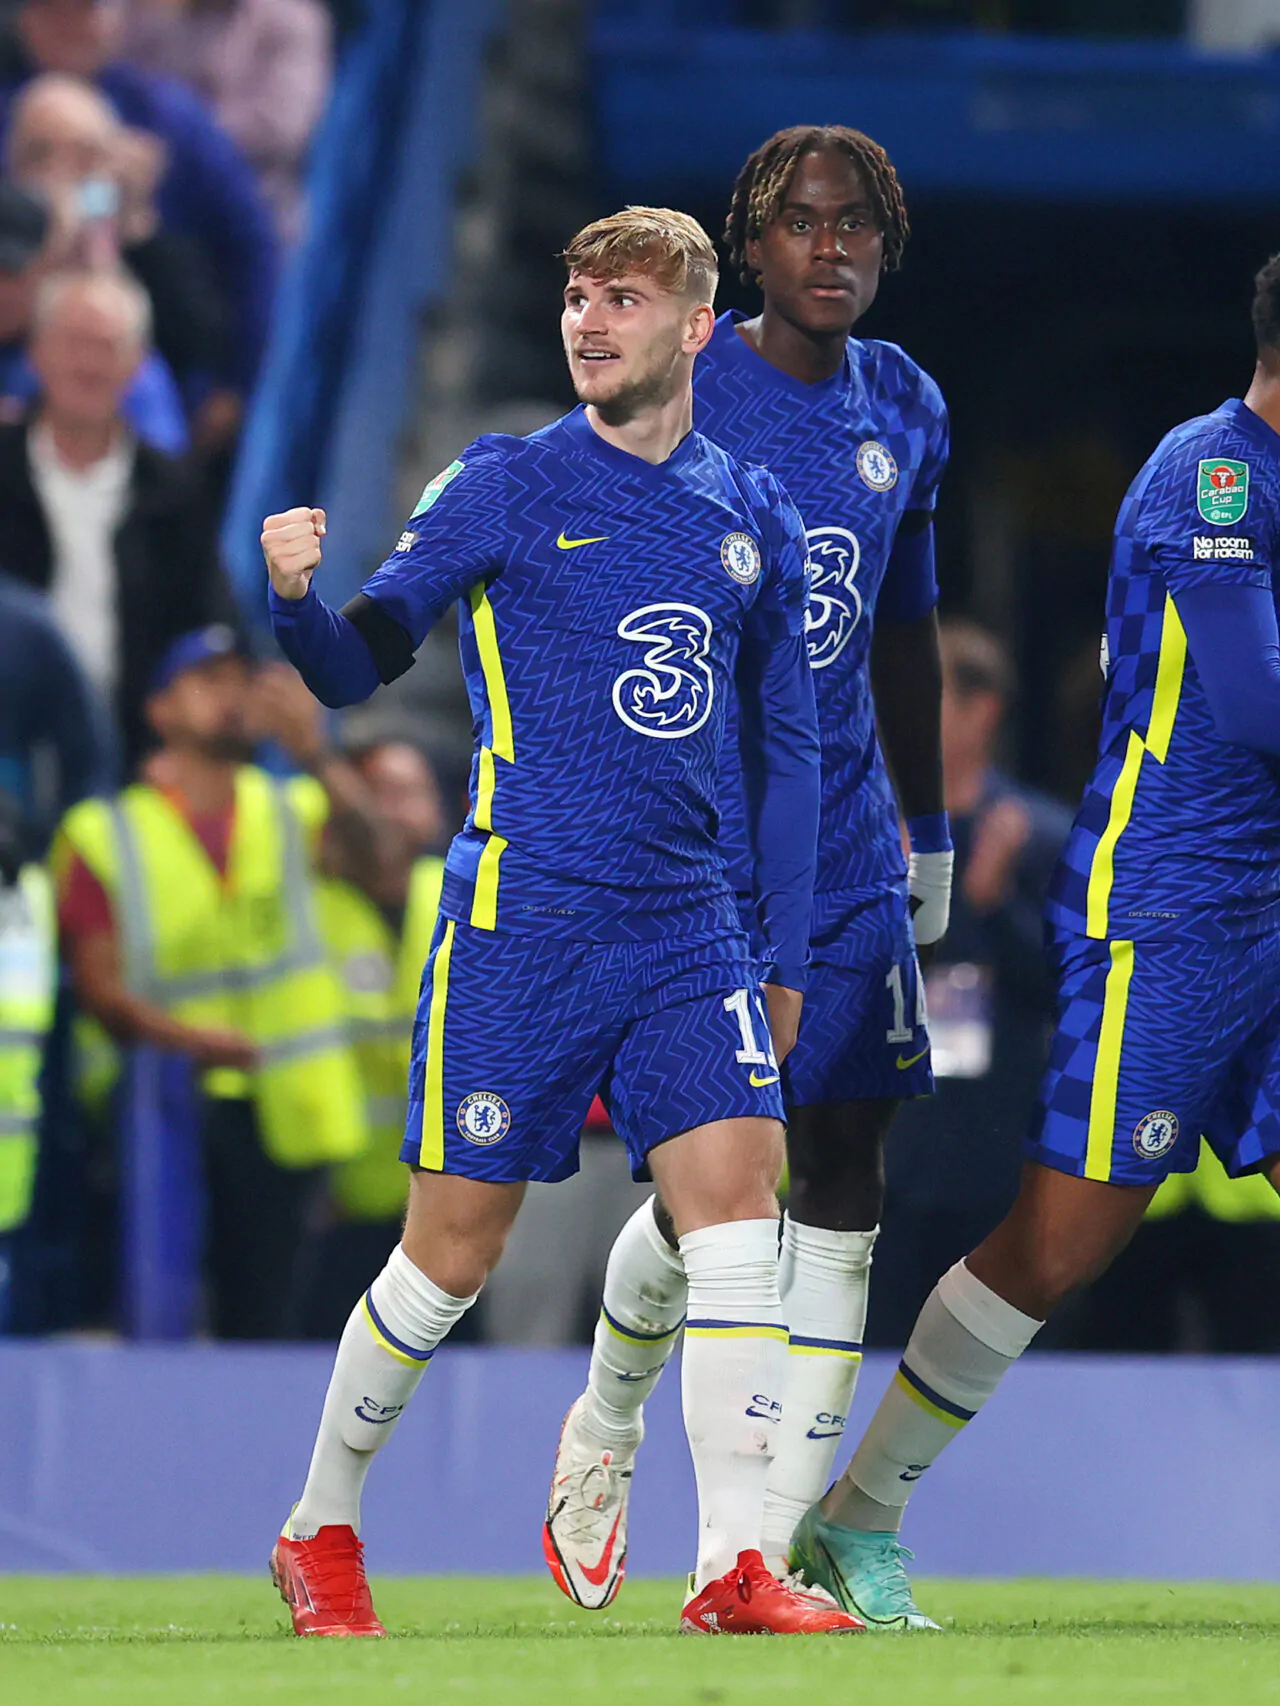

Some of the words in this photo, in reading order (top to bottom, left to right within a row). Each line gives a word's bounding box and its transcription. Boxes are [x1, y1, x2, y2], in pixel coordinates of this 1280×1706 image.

[1201, 485, 1245, 499] Carabao
[1211, 496, 1233, 505] Cup
[1193, 536, 1214, 549] No
[1215, 537, 1250, 549] room
[612, 602, 714, 740] 3
[467, 1094, 502, 1107] CHELSEA
[363, 1397, 404, 1414] CF
